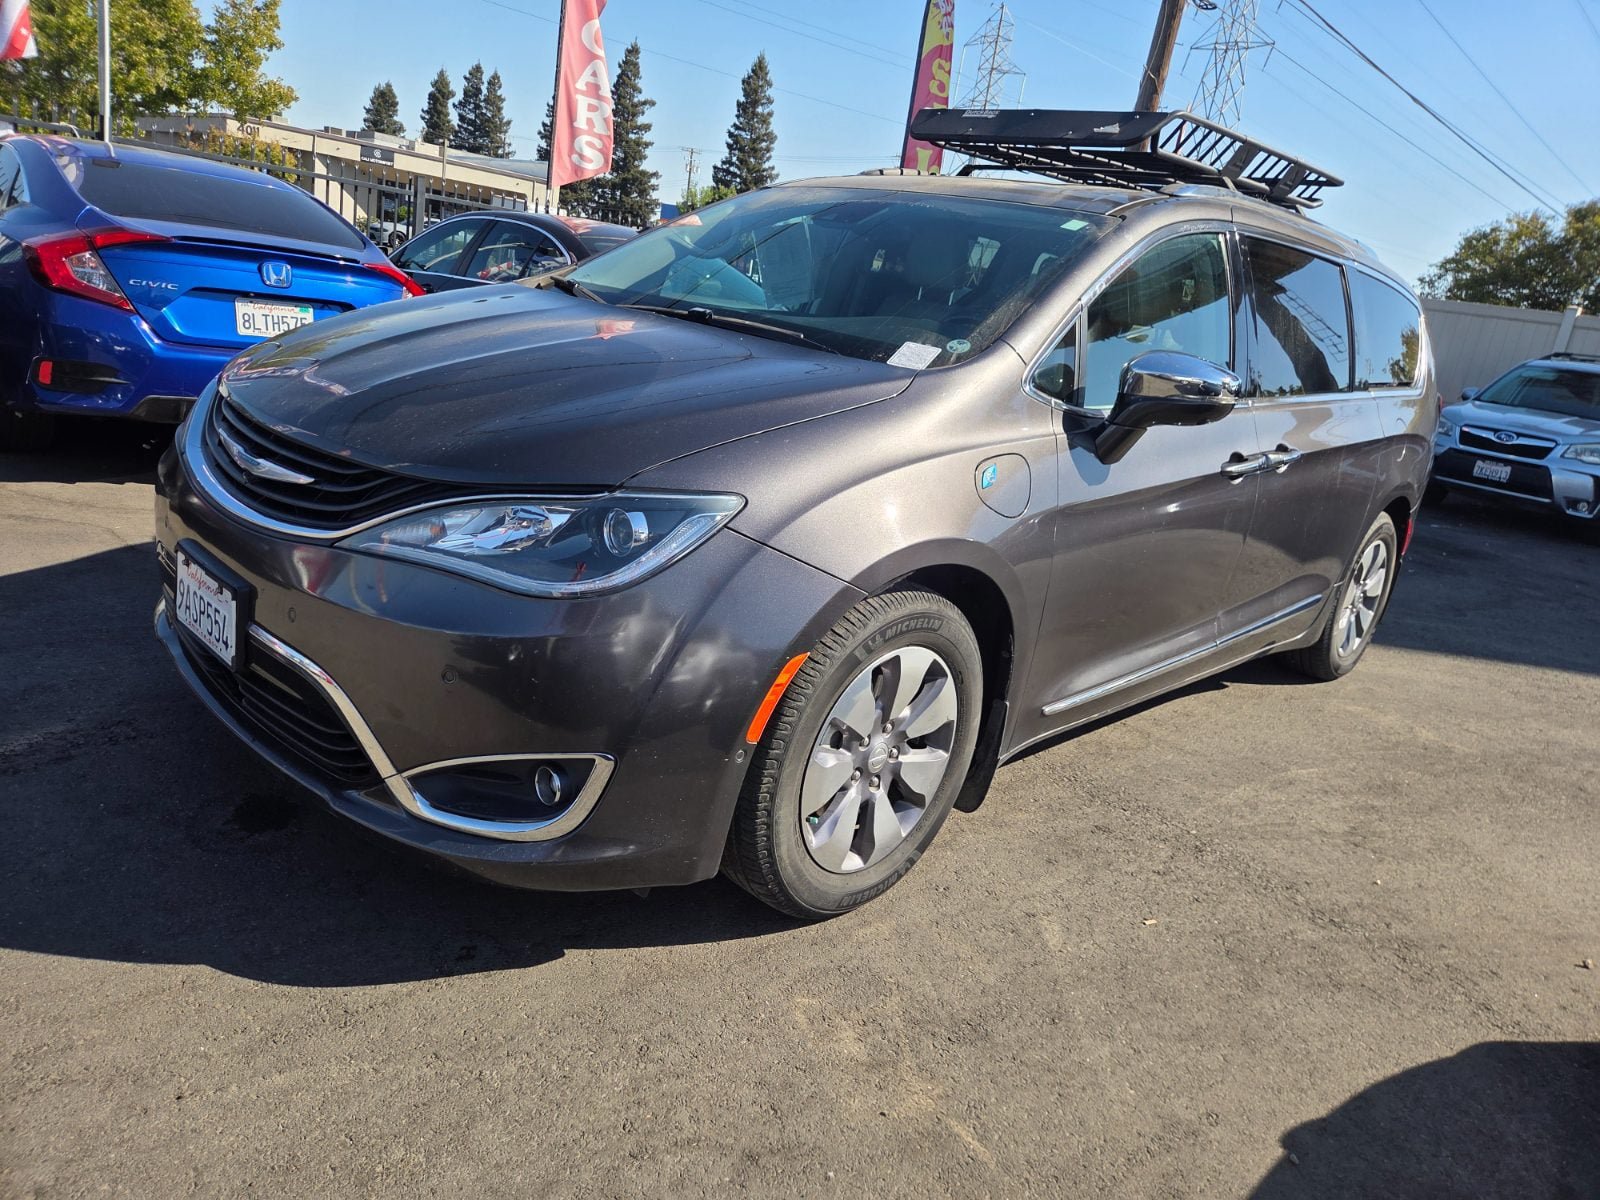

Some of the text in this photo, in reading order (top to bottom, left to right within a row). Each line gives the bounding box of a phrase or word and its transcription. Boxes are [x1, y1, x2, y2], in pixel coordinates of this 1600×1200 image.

[571, 19, 613, 170] CARS
[237, 123, 260, 137] 4011
[128, 278, 179, 290] CIVIC
[178, 578, 230, 652] 9ASP554
[884, 618, 943, 642] MICHELIN
